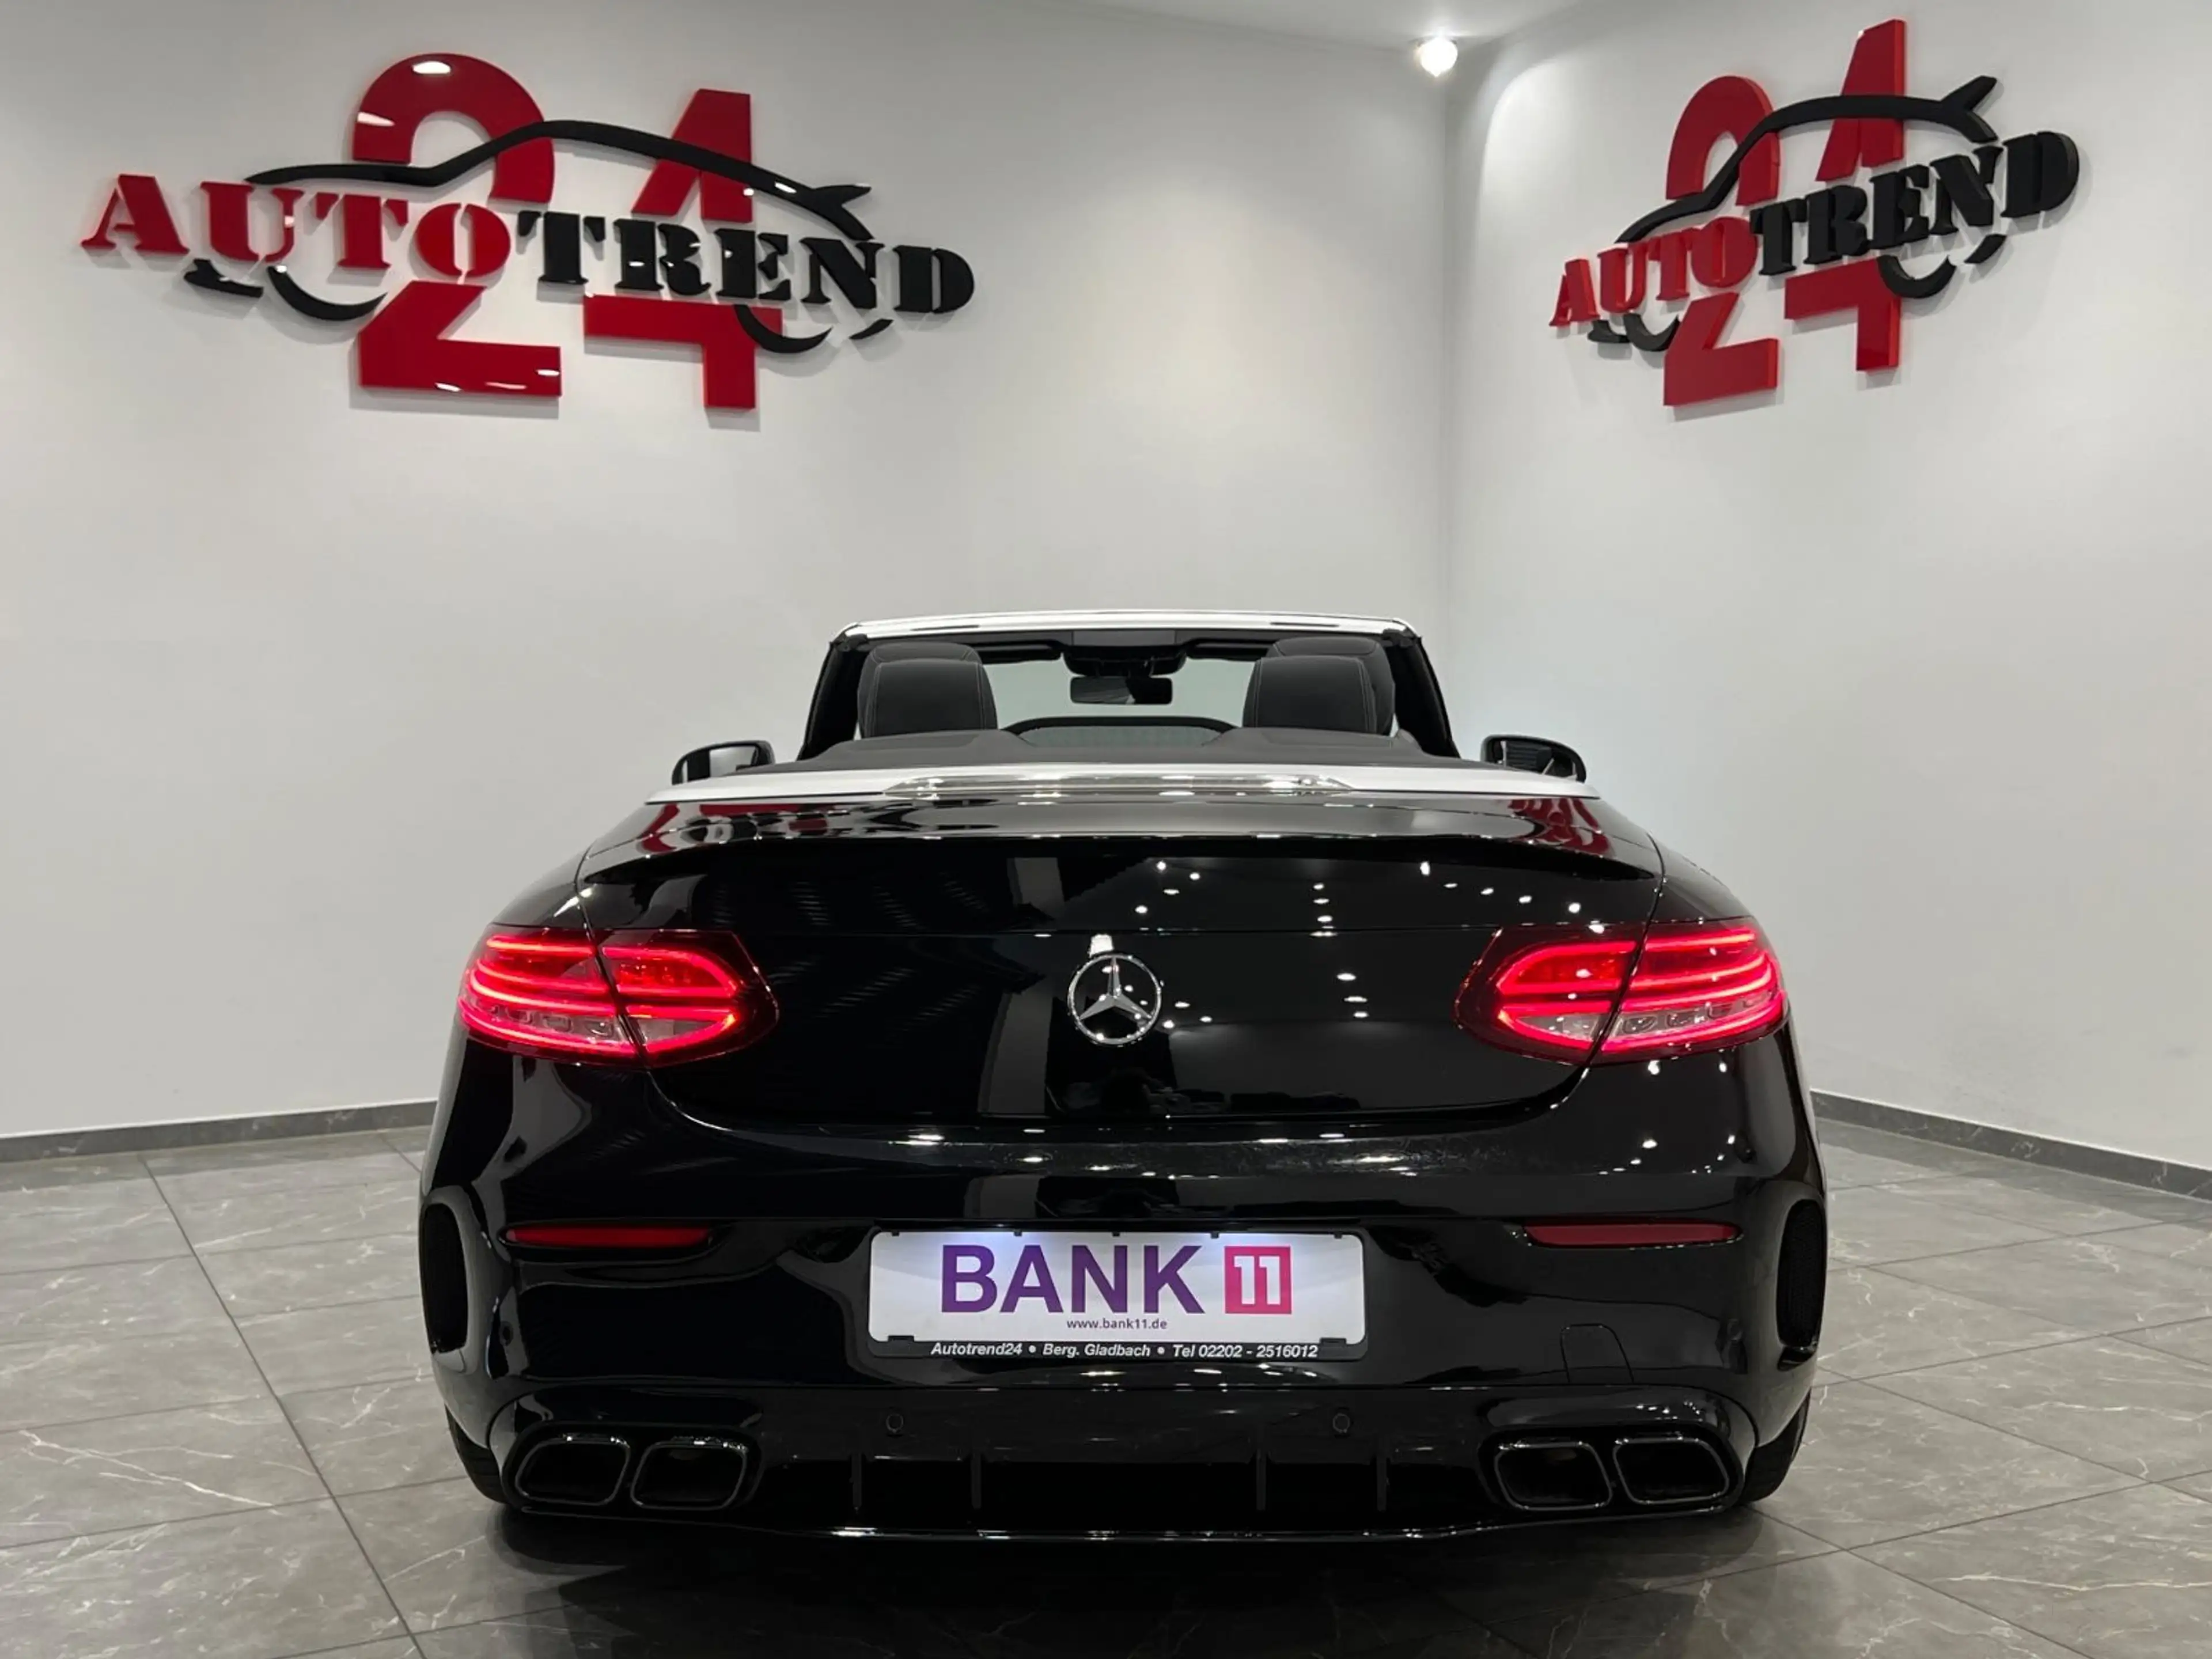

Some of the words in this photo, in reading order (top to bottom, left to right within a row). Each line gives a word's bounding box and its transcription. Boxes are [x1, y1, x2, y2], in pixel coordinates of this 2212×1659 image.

[80, 173, 975, 315] AUTOTREND
[351, 53, 783, 410] 24
[1548, 131, 2080, 327] AUTOTREND
[1662, 18, 1907, 407] 24
[930, 1342, 1022, 1355] Autotrend24
[1042, 1343, 1080, 1358] Berg.
[1084, 1344, 1151, 1357] Gladbach
[1173, 1344, 1195, 1357] Tel
[1198, 1344, 1243, 1358] 02202
[1256, 1344, 1319, 1358] 2516012
[941, 1244, 1205, 1314] BANK
[1231, 1253, 1283, 1306] 11
[1066, 1318, 1167, 1330] www.bank11.de
